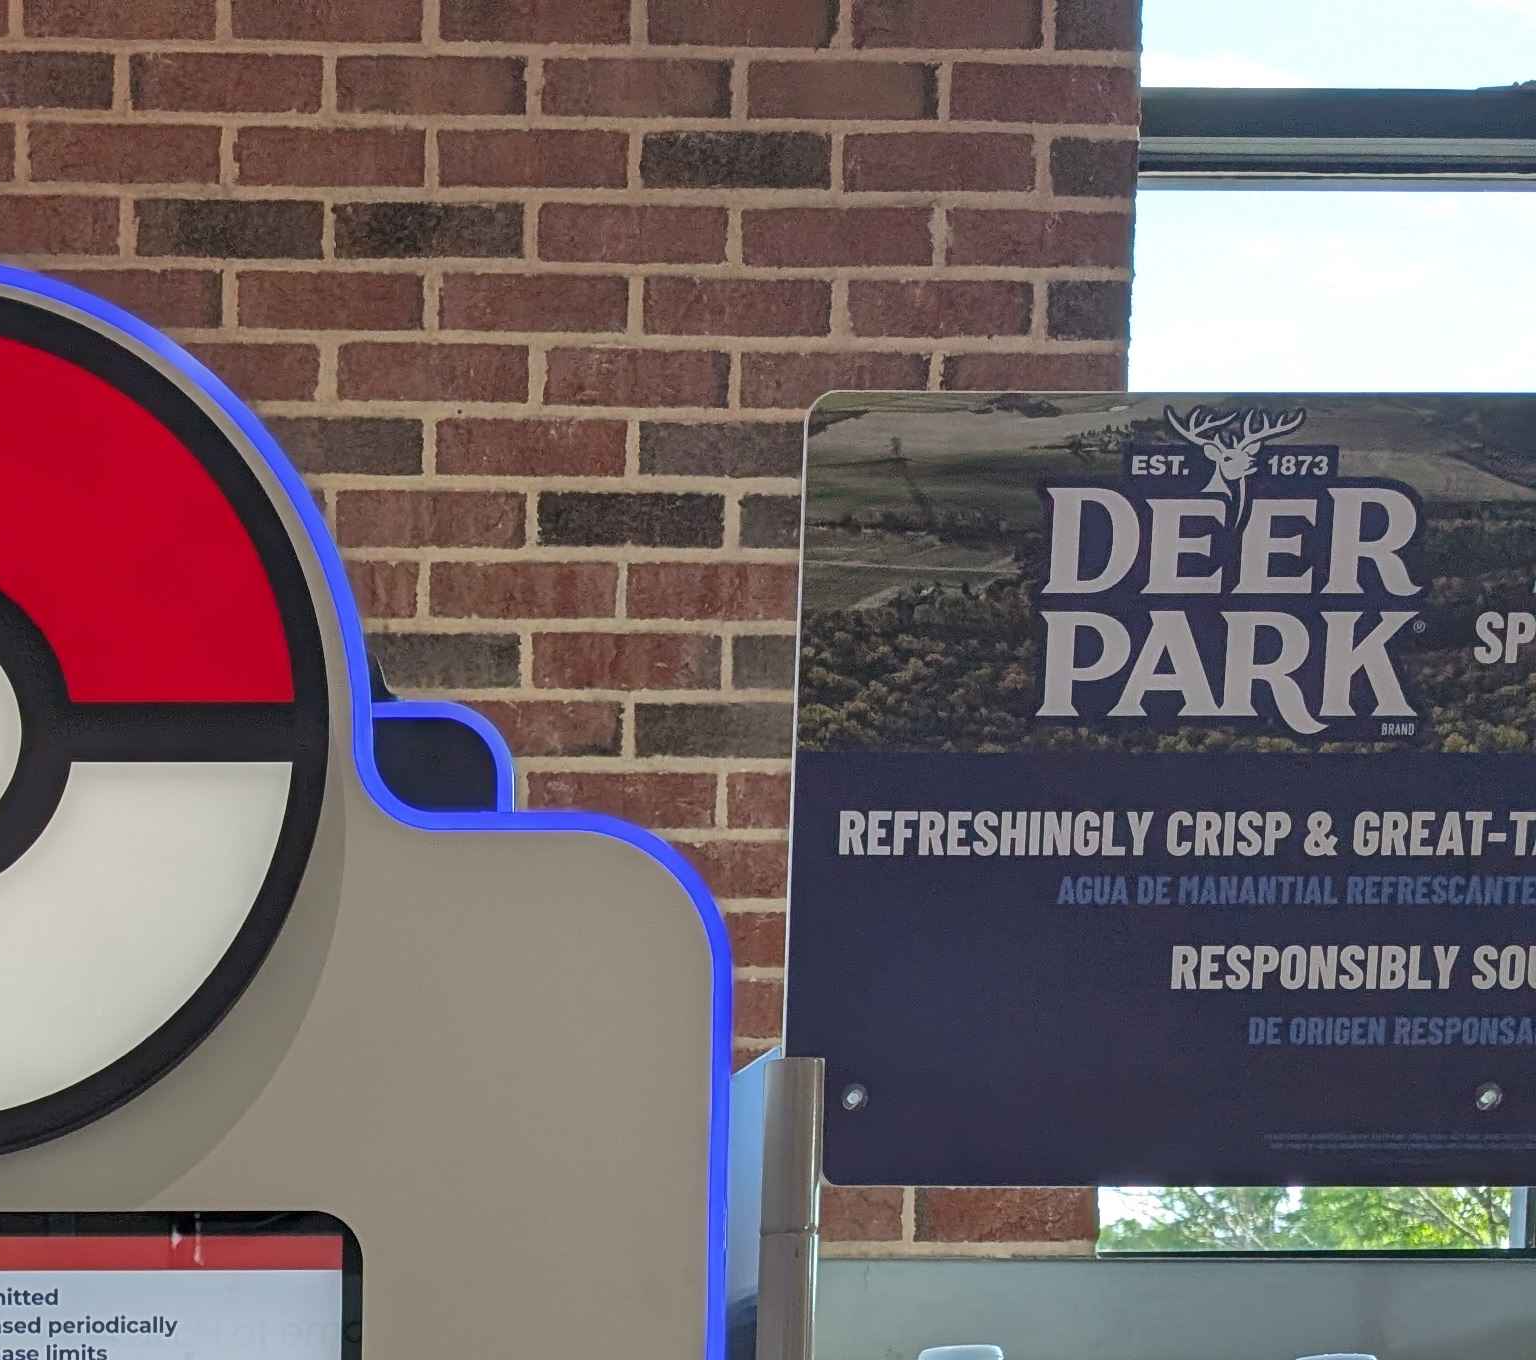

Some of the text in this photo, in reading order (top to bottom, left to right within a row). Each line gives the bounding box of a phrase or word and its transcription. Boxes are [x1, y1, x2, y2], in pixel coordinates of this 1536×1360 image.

[1131, 455, 1330, 476] EST. 1873
[1040, 486, 1425, 597] DEER
[1381, 722, 1415, 737] BRAND
[838, 810, 1536, 857] REFRESHINGLY CRISP & GREAT-T
[1056, 875, 1536, 907] AGUA DE MANANTIAL REFRESCANTE
[1170, 944, 1461, 990] RESPONSIBLY
[1247, 1016, 1283, 1045] DE
[1289, 1015, 1387, 1046] ORIGEN
[48, 1315, 178, 1338] periodically
